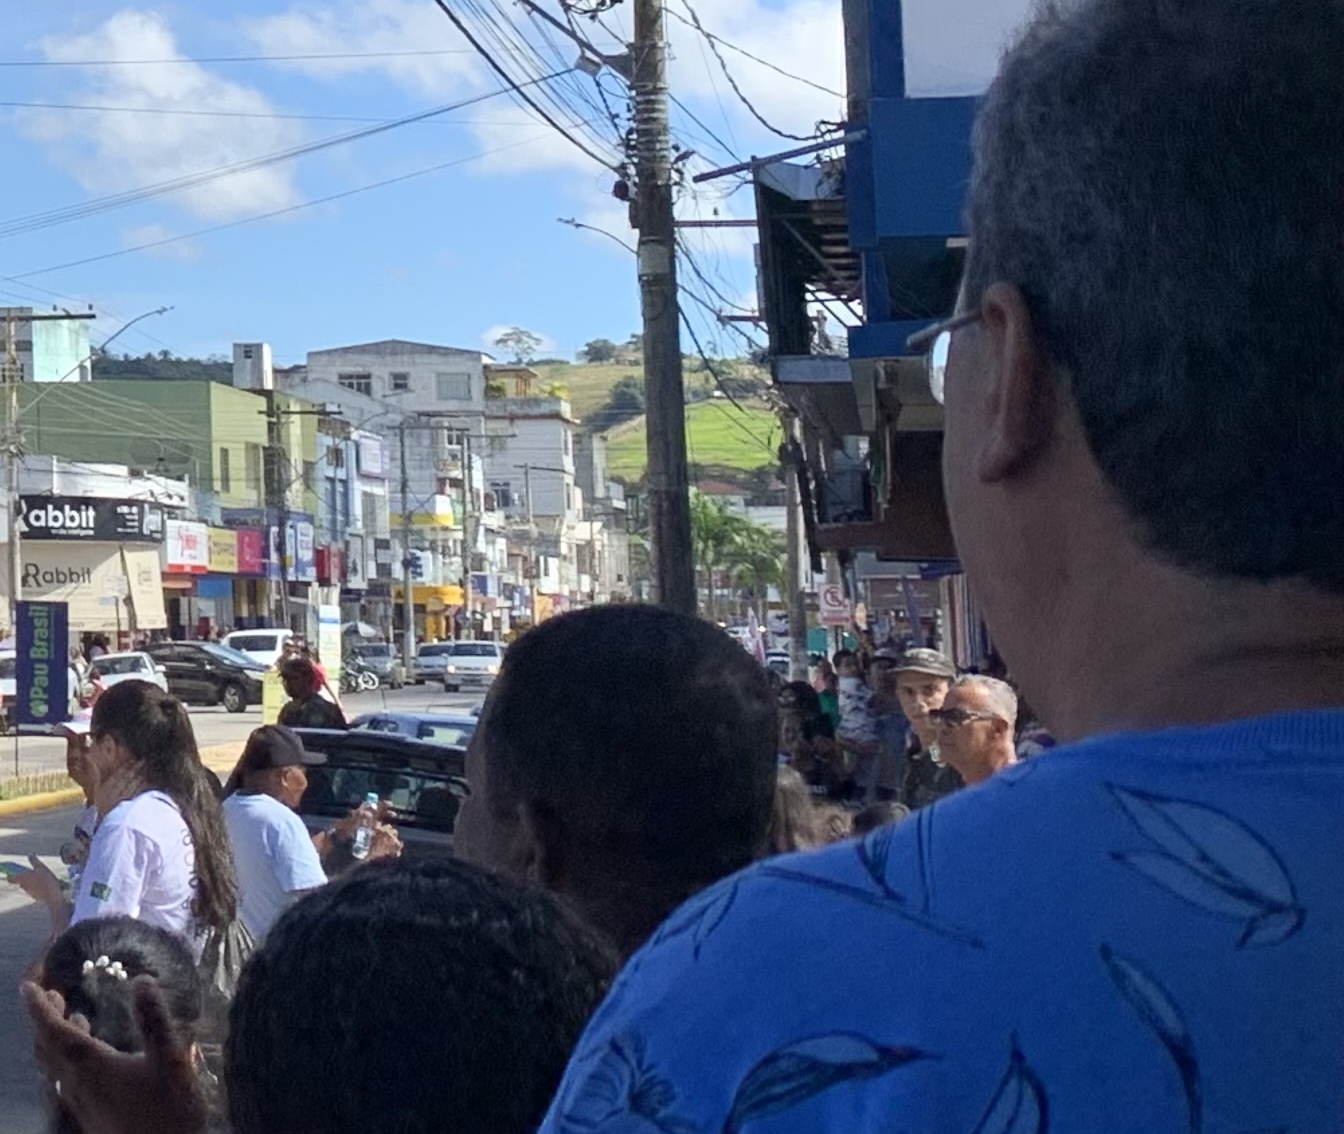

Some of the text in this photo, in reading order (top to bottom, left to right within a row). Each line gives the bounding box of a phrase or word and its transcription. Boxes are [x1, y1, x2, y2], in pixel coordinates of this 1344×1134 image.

[21, 563, 91, 588] Rabbit
[29, 605, 49, 699] Pau Brasil
